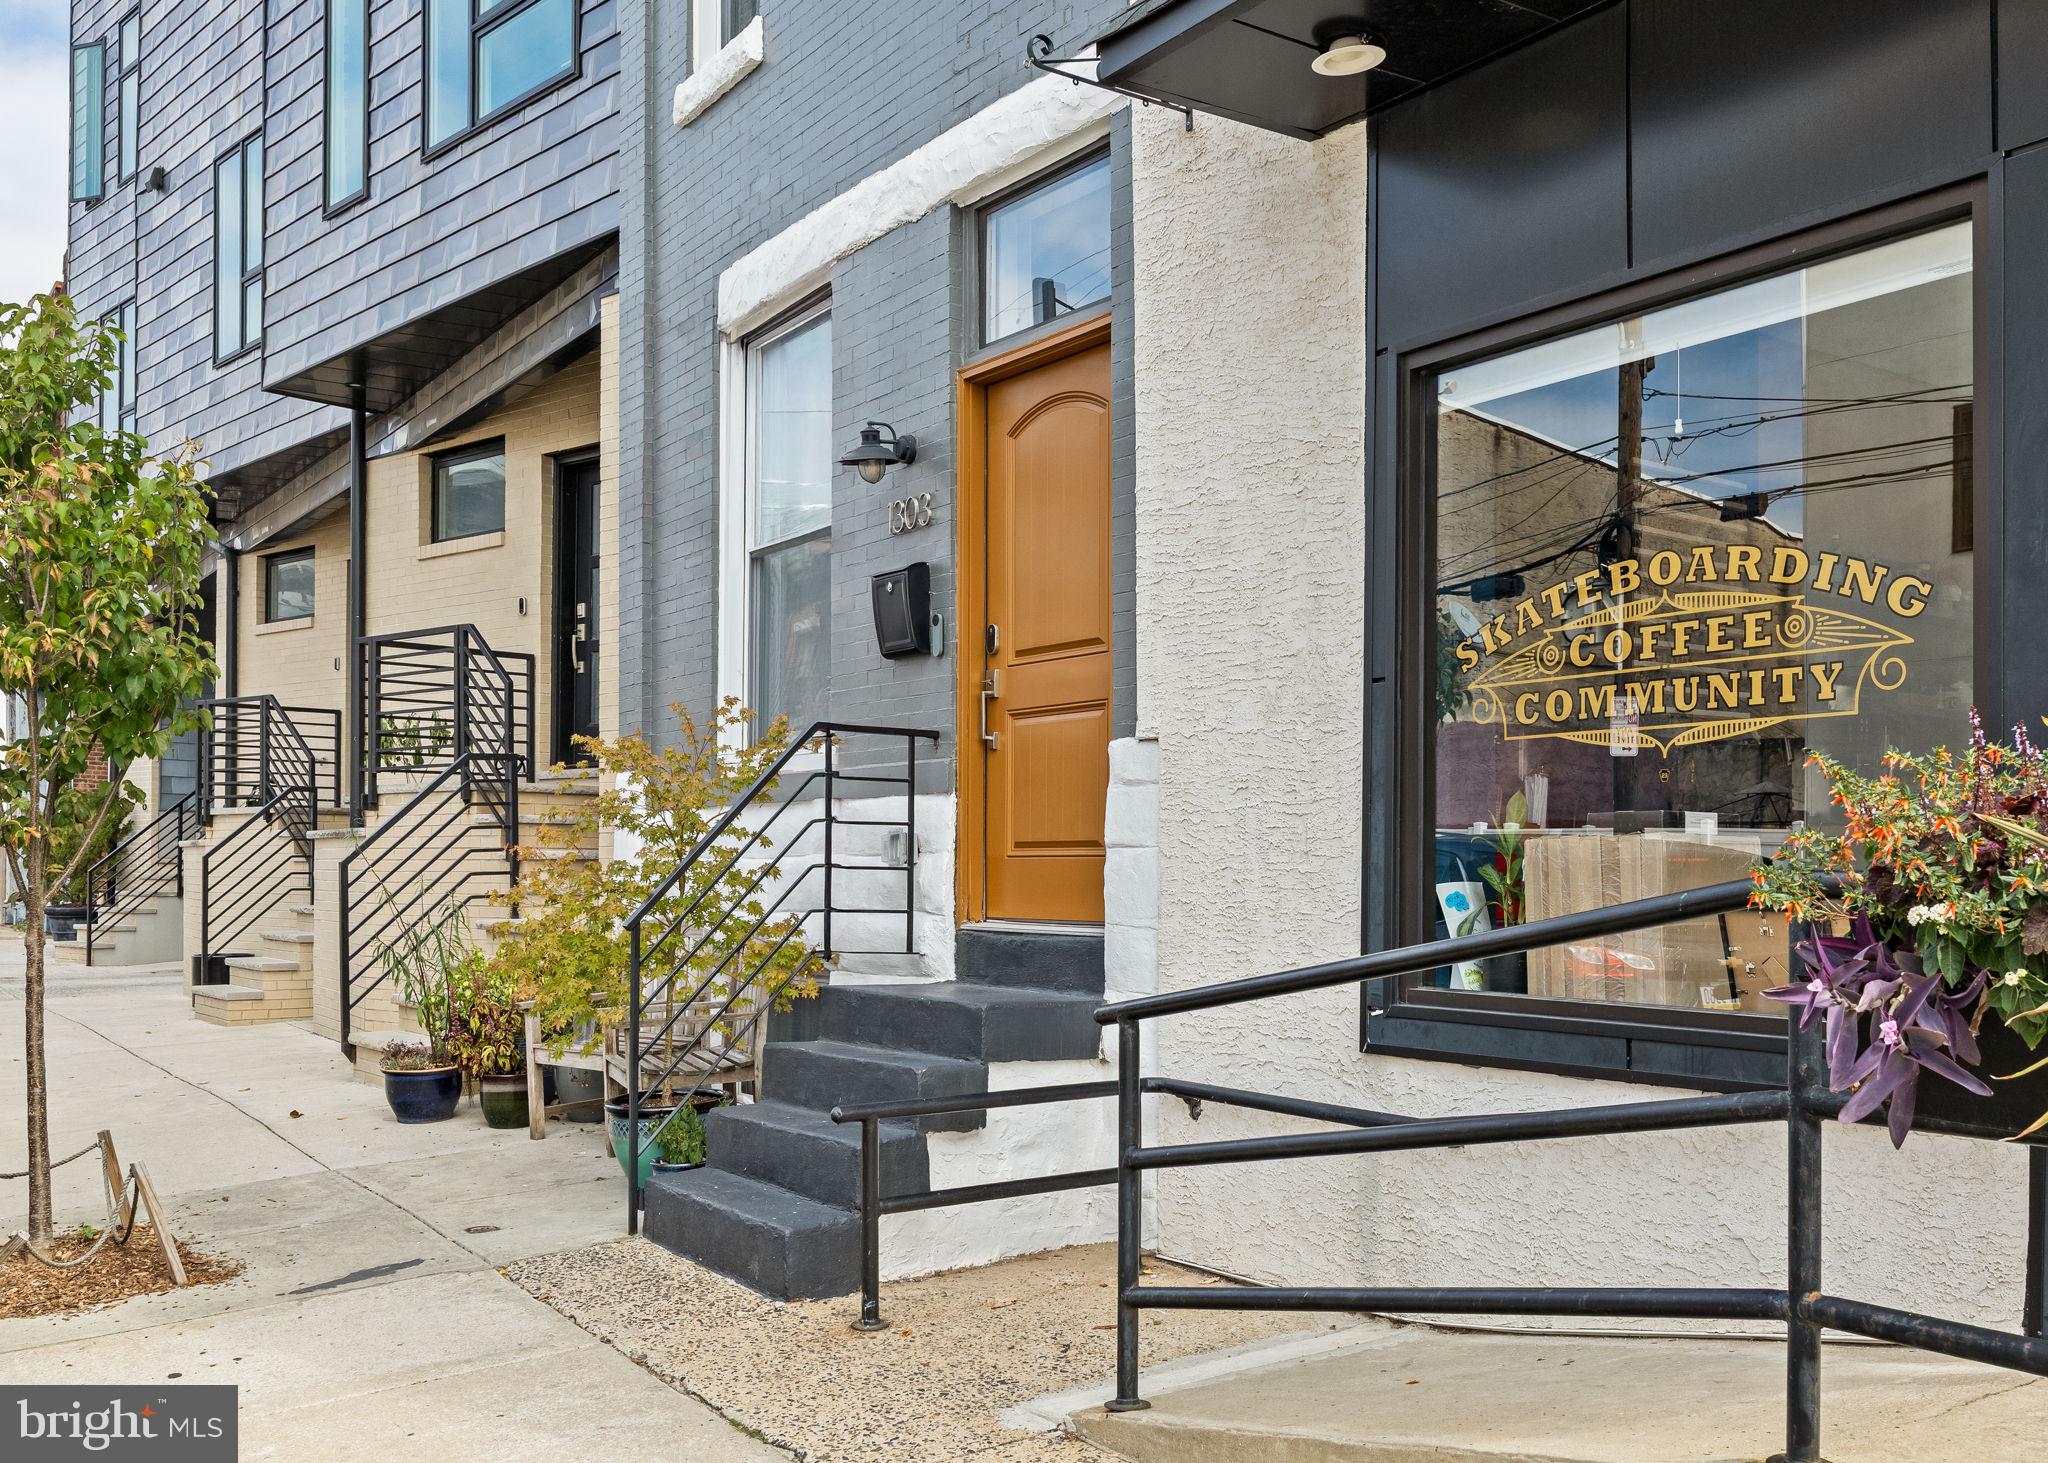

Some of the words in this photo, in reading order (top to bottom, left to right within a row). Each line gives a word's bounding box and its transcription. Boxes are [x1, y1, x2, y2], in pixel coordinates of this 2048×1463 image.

[887, 493, 932, 535] 1303
[1455, 545, 1934, 674] SKATEBOARDING
[1569, 609, 1773, 668] COFFEE
[1515, 661, 1845, 725] COMMUNITY
